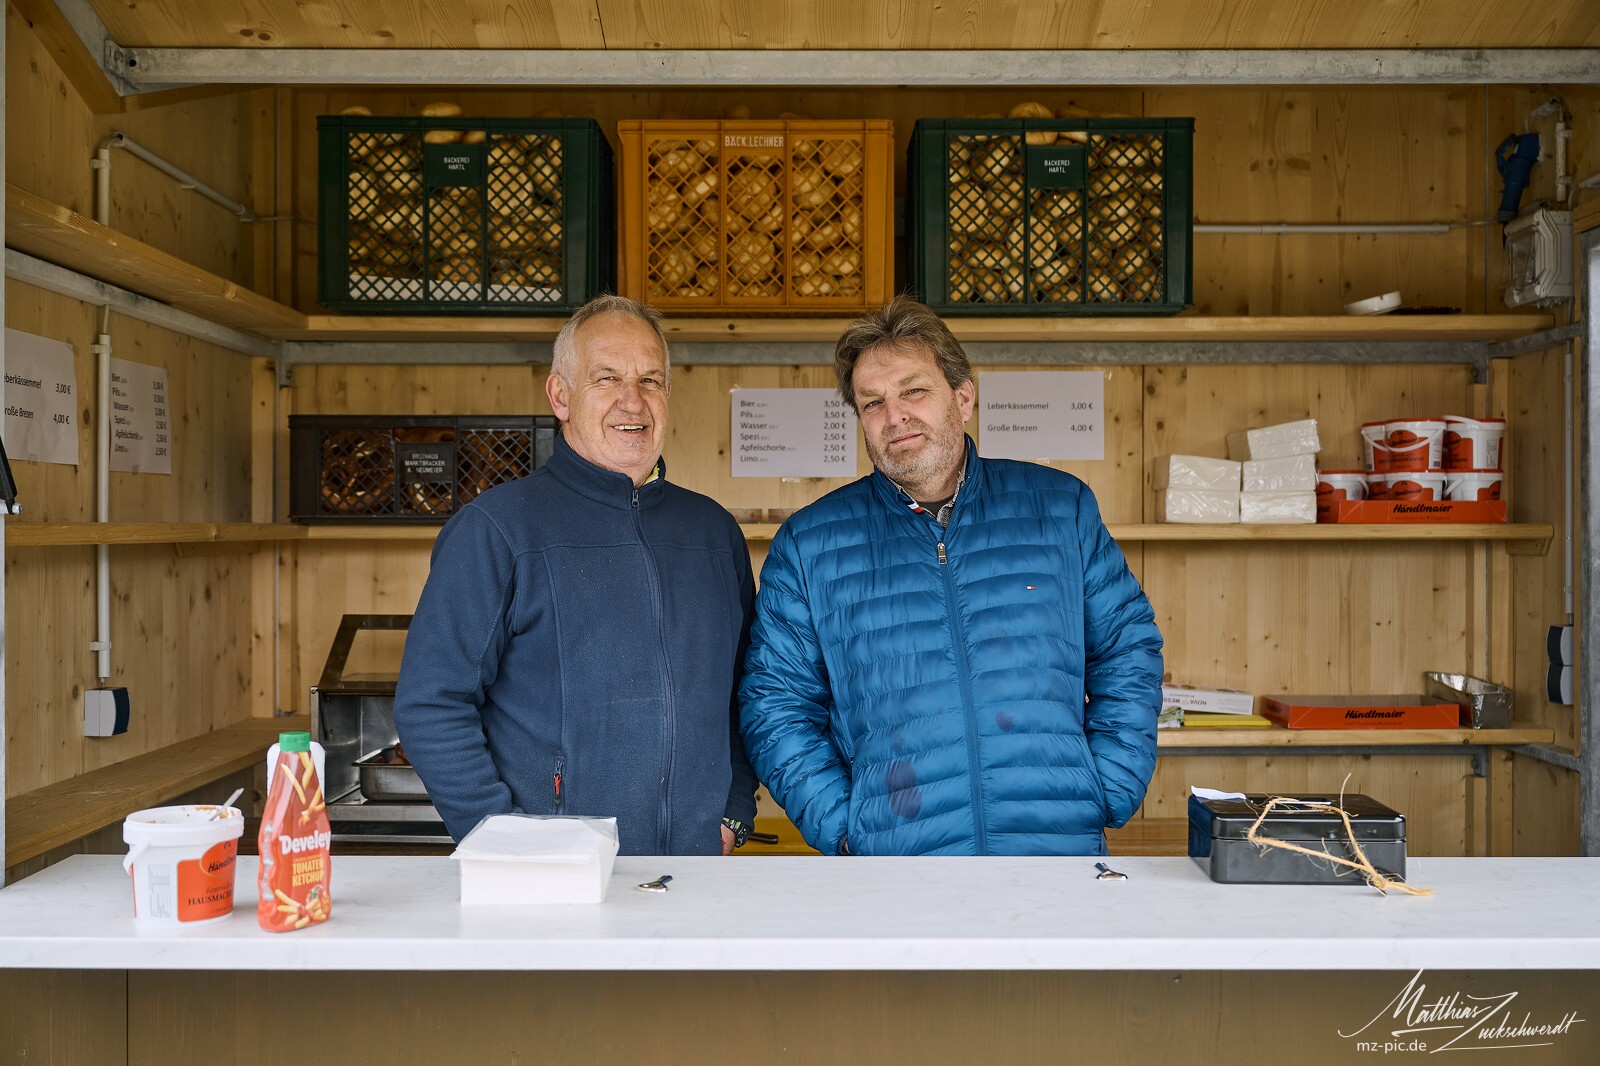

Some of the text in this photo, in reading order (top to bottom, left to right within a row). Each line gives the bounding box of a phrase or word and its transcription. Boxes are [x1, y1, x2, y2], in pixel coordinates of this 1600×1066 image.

[111, 373, 120, 383] Bier
[56, 383, 67, 394] 3,00
[67, 385, 71, 395] €
[112, 387, 120, 397] Pils
[113, 401, 129, 411] Wasser
[740, 400, 755, 408] Bier
[824, 400, 840, 408] 3,50
[987, 402, 1093, 411] Leberkässemmel 3,00 €
[19, 408, 34, 419] Brezen
[53, 413, 65, 424] 4,00
[65, 415, 70, 425] €
[824, 411, 840, 419] 3,50
[824, 422, 840, 430] 2,00
[841, 422, 846, 430] €
[987, 424, 1093, 433] Große Brezen 4,00 €
[740, 433, 759, 441] Spezi
[824, 433, 840, 441] 2,50
[841, 433, 846, 441] €
[740, 444, 786, 452] Apfelschorle
[824, 444, 840, 452] 2,50
[824, 455, 840, 463] 2,50
[1393, 503, 1453, 513] Händlmaier
[1344, 709, 1406, 719] Händlmaier
[279, 830, 331, 855] Develey
[292, 859, 324, 875] TOMATEN
[292, 869, 325, 888] KETCHUP
